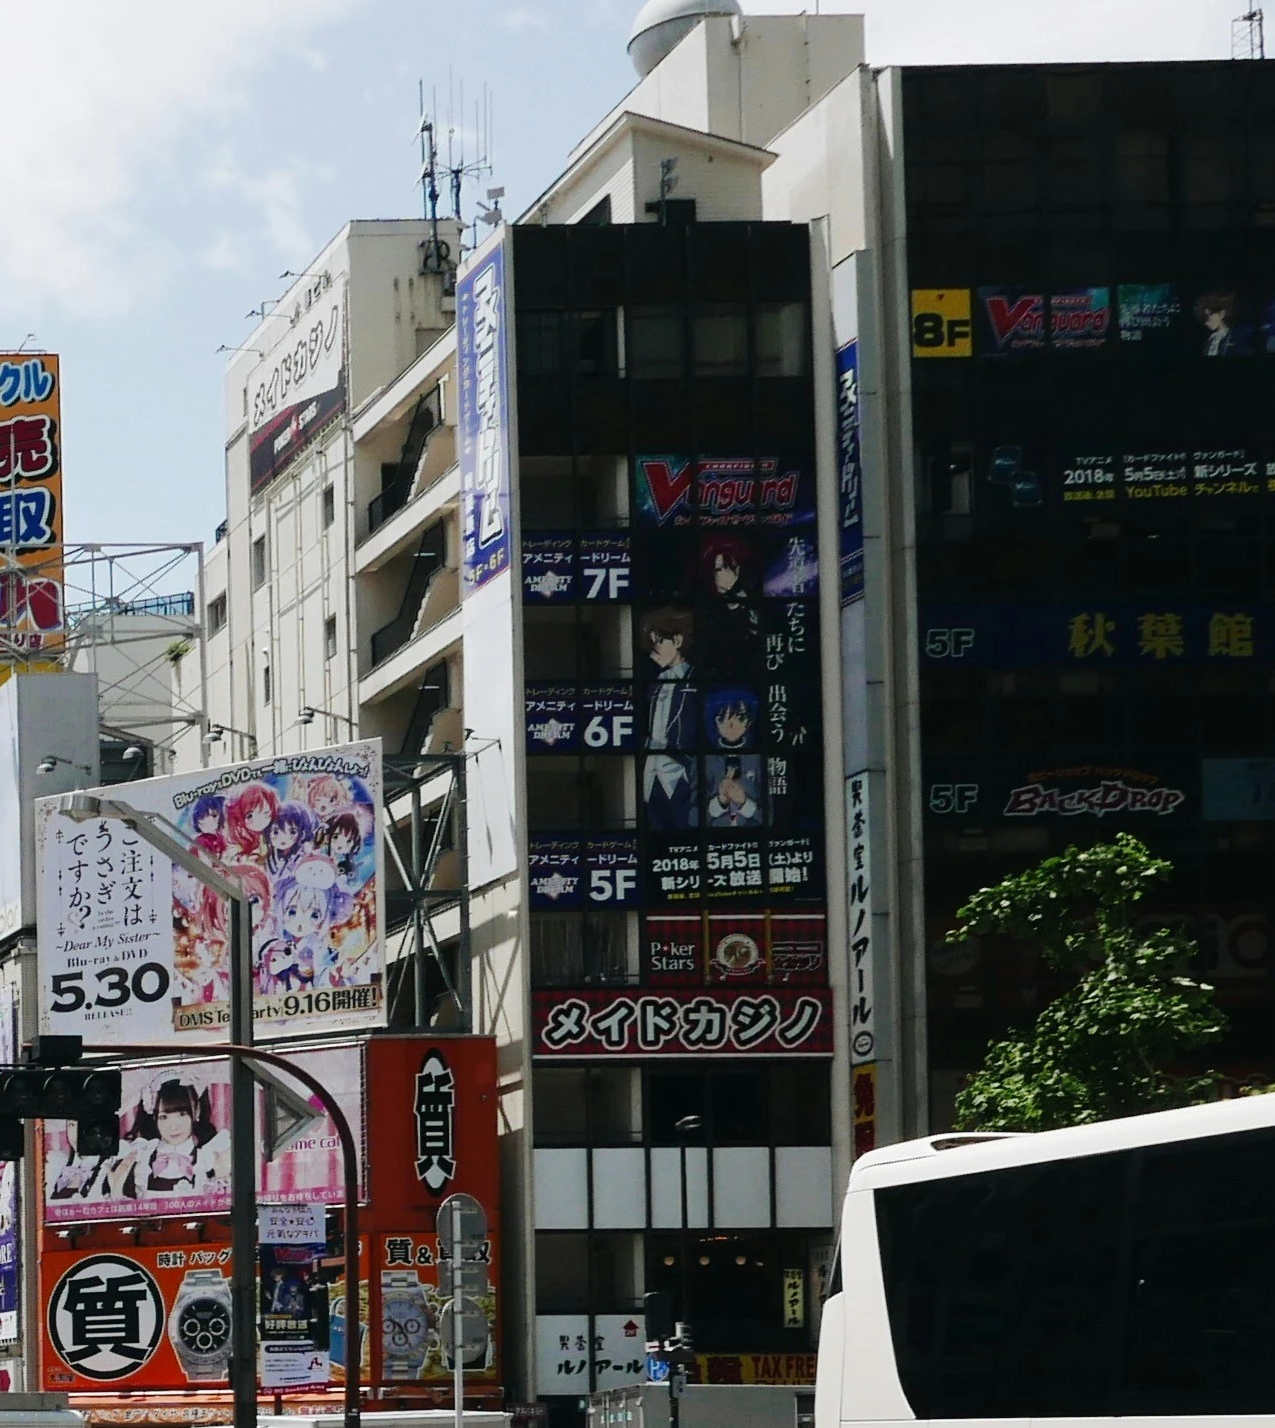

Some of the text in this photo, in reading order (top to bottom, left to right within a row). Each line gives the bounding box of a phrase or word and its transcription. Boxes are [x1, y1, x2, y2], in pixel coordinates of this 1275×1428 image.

[912, 312, 971, 348] 8F
[1124, 484, 1188, 499] YouTube
[582, 568, 630, 599] 7F
[925, 627, 975, 658] 5F
[1065, 612, 1255, 659] 秋葉館
[582, 715, 633, 747] 6F
[767, 757, 789, 796] 物語
[929, 783, 979, 815] 5F
[588, 869, 637, 901] 5F
[97, 936, 114, 952] My
[850, 873, 870, 1026] ルノアール
[650, 955, 696, 971] Stars
[51, 961, 169, 1012] 5.30
[542, 996, 823, 1051] メイドカジノ
[414, 1069, 456, 1181] 質
[158, 1251, 184, 1268] 時計
[386, 1237, 413, 1264] 質
[63, 1270, 152, 1364] 質
[558, 1334, 605, 1351] 喫茶室
[556, 1358, 644, 1376] ルノアール
[752, 1356, 782, 1379] TAX
